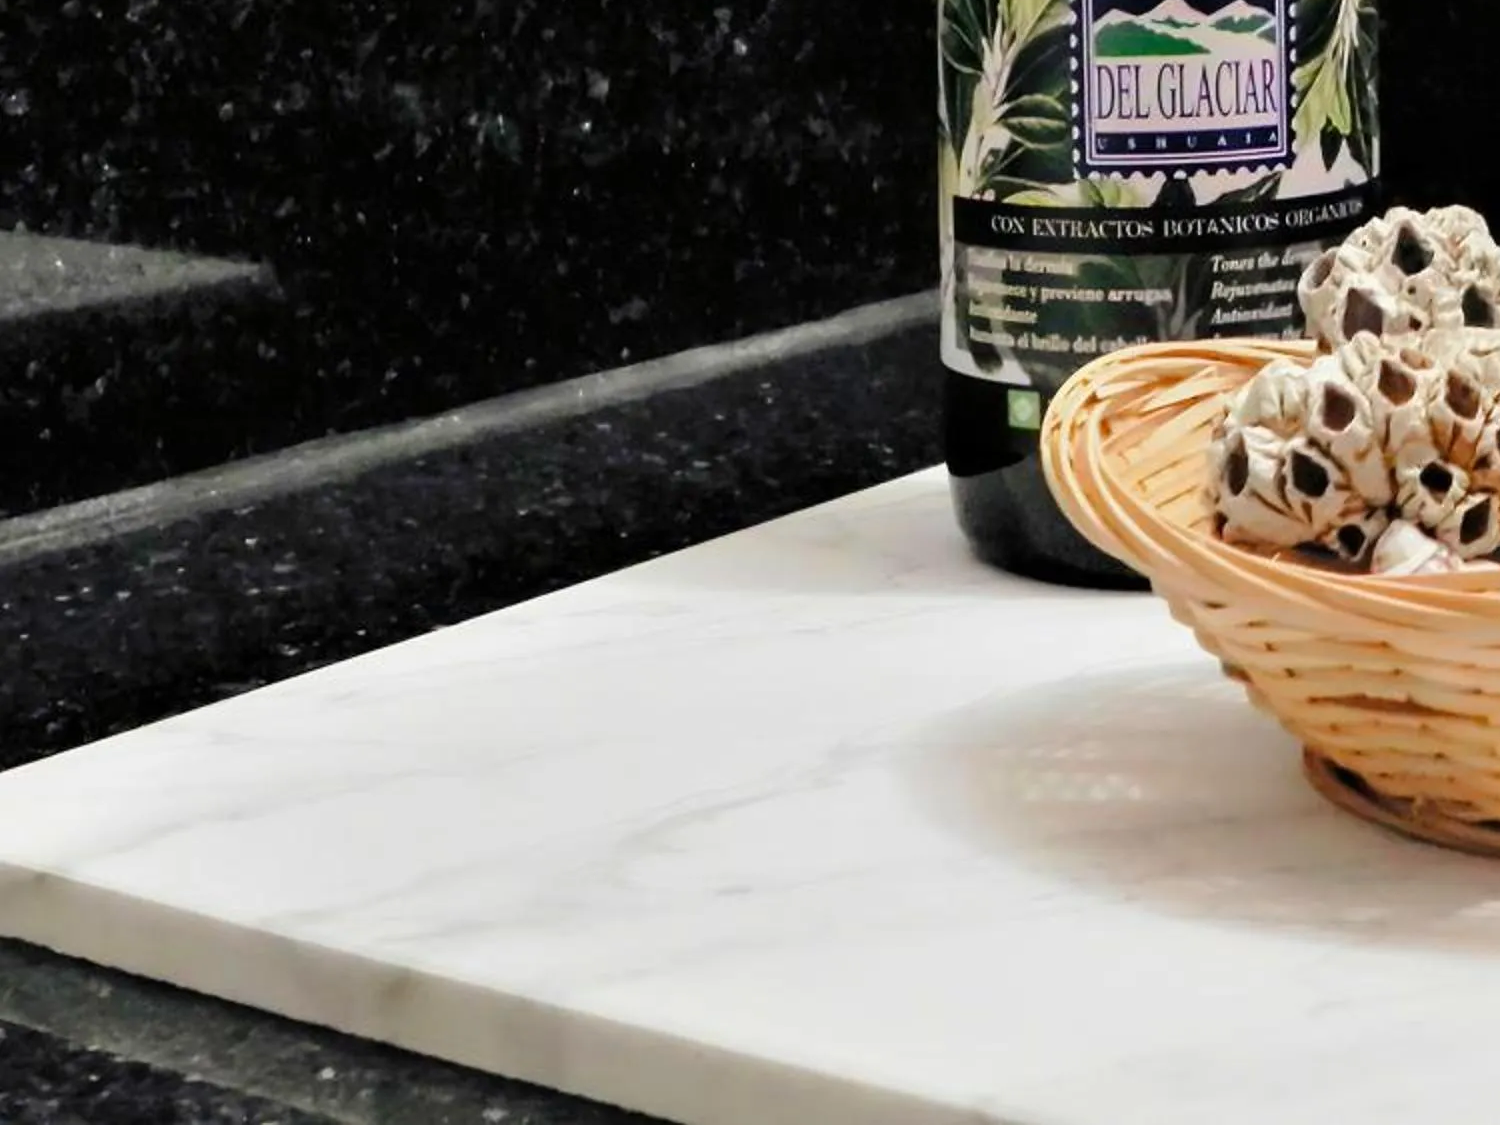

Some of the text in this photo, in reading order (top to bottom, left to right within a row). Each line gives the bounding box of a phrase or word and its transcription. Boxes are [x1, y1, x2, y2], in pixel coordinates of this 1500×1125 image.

[1095, 59, 1278, 120] DEL GLACIAR
[991, 215, 1025, 234] CON
[1032, 218, 1154, 238] EXTRACTOS
[1164, 212, 1279, 237] BOTANICOS
